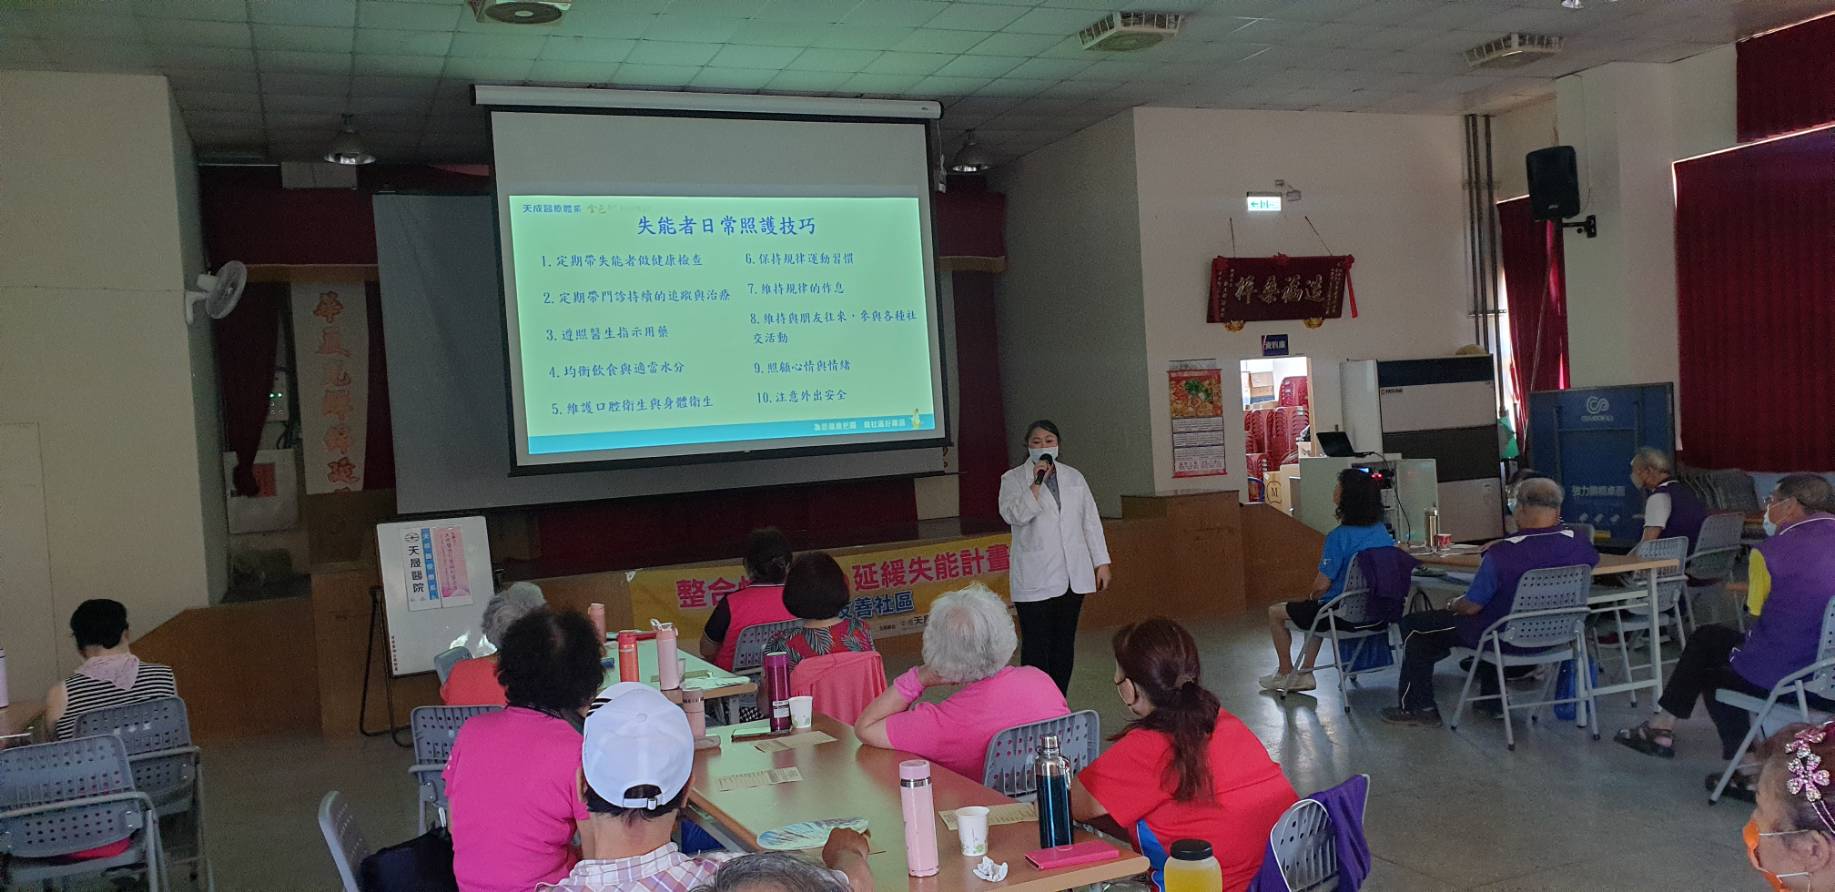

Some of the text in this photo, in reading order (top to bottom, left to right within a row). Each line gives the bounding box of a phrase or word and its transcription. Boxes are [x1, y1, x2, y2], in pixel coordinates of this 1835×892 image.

[637, 215, 816, 236] 失能者日常照護技巧
[556, 254, 704, 268] 定期帶失能者做健康檢查
[759, 252, 854, 265] 保持規律運動習慣
[761, 281, 847, 295] 維持規律的作息
[559, 288, 731, 305] 定期帶門診持續的追蹤與治療
[561, 326, 669, 342] 遵照醫生指示用藥
[753, 331, 789, 344] 交活動
[563, 361, 686, 378] 均衡飲食與適當水分
[767, 358, 851, 374] 照顧心情與情緒
[775, 389, 847, 404] 注意外出安全
[567, 395, 714, 415] 維護口腔衛生與身體衛生
[852, 543, 1010, 591] 延緩失能計畫
